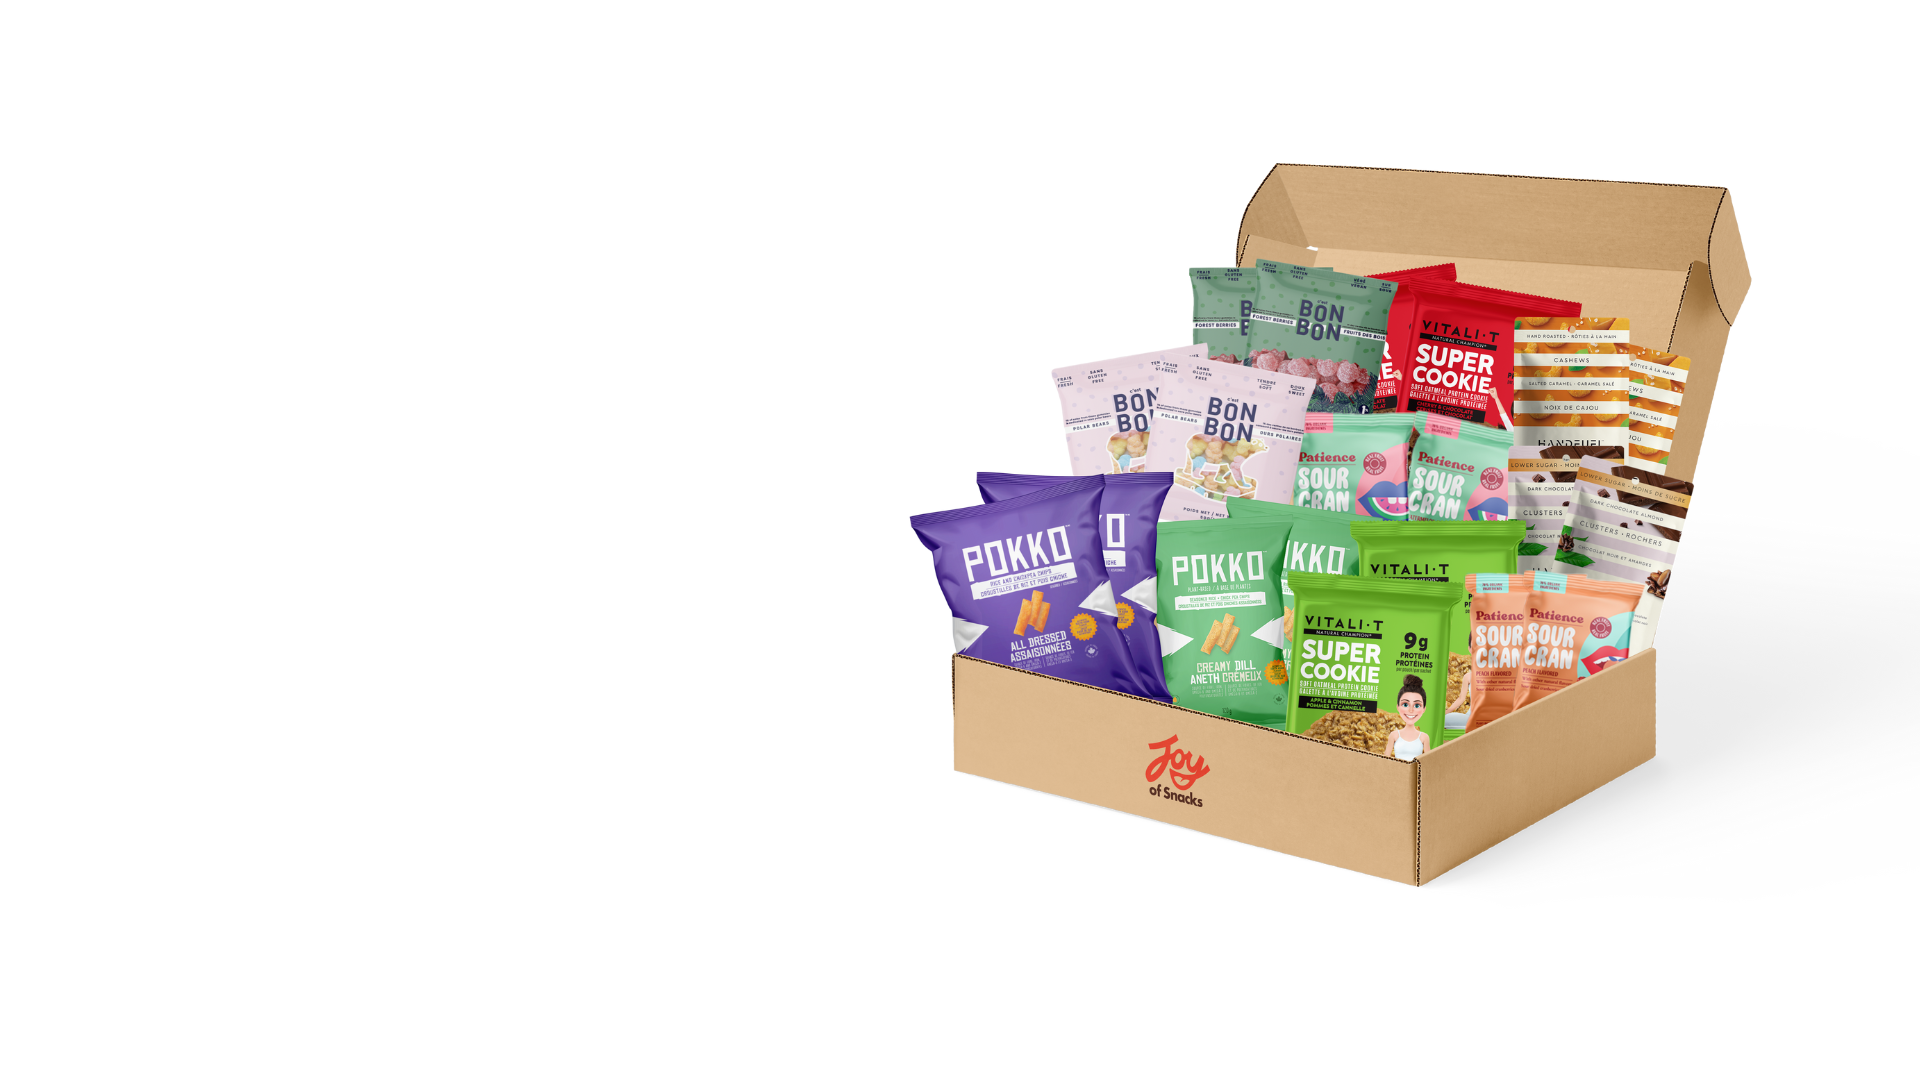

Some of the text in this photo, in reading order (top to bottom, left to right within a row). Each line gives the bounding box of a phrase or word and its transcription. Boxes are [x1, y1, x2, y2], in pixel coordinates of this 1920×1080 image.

[1299, 300, 1344, 323] BON
[1296, 318, 1341, 341] BON
[1416, 344, 1494, 375] SUPER
[1413, 366, 1492, 394] COOKIE
[1410, 391, 1431, 401] GALETTE
[1411, 383, 1488, 403] SOFT OATMEAL PROTEIN COOKIE
[1208, 397, 1257, 422] BON
[1443, 406, 1473, 415] CHOCOLATE
[1445, 412, 1473, 420] CHOCOLAT
[1073, 423, 1090, 431] POLAR
[1204, 417, 1253, 442] BON
[1276, 433, 1302, 441] POLAIRES
[1299, 452, 1356, 462] Patience
[1418, 452, 1475, 472] Patience
[1298, 467, 1349, 489] SOUR
[1413, 467, 1465, 497] SOUR
[1580, 472, 1603, 482] LOWER
[1604, 477, 1626, 488] SUGAR
[1632, 485, 1652, 495] MOINS
[1665, 494, 1686, 503] SUCRE
[1298, 491, 1349, 512] CRAN
[1409, 491, 1461, 519] CRAN
[1590, 499, 1664, 522] DARK CHOCOLATE ALMOND
[1580, 520, 1662, 547] CLUSTERS ROCHERS
[962, 525, 1072, 583] POKKO
[1578, 544, 1605, 555] CHOCOLAT
[1013, 572, 1036, 580] CHICKPEA
[1172, 551, 1264, 586] POKKO
[981, 586, 1012, 597] CROUSTILLES
[1476, 611, 1524, 621] Patienc
[1529, 608, 1584, 624] Patience
[1011, 631, 1066, 651] ALL DRESSED
[1476, 625, 1523, 646] SOUR
[1527, 622, 1576, 648] SOUR
[1011, 641, 1072, 662] ASSAISONNÉES
[1301, 639, 1381, 664] SUPER
[1476, 648, 1521, 669] CRAN
[1524, 645, 1573, 670] CRAN
[1197, 660, 1256, 673] CREAMY DILL
[1300, 662, 1380, 684] COOKIE
[1396, 659, 1433, 668] PROTÉINES
[1537, 669, 1558, 677] FLAVORED
[1190, 673, 1220, 685] ANETH
[1145, 734, 1210, 791] Joy
[1149, 784, 1203, 807] of Snacks
